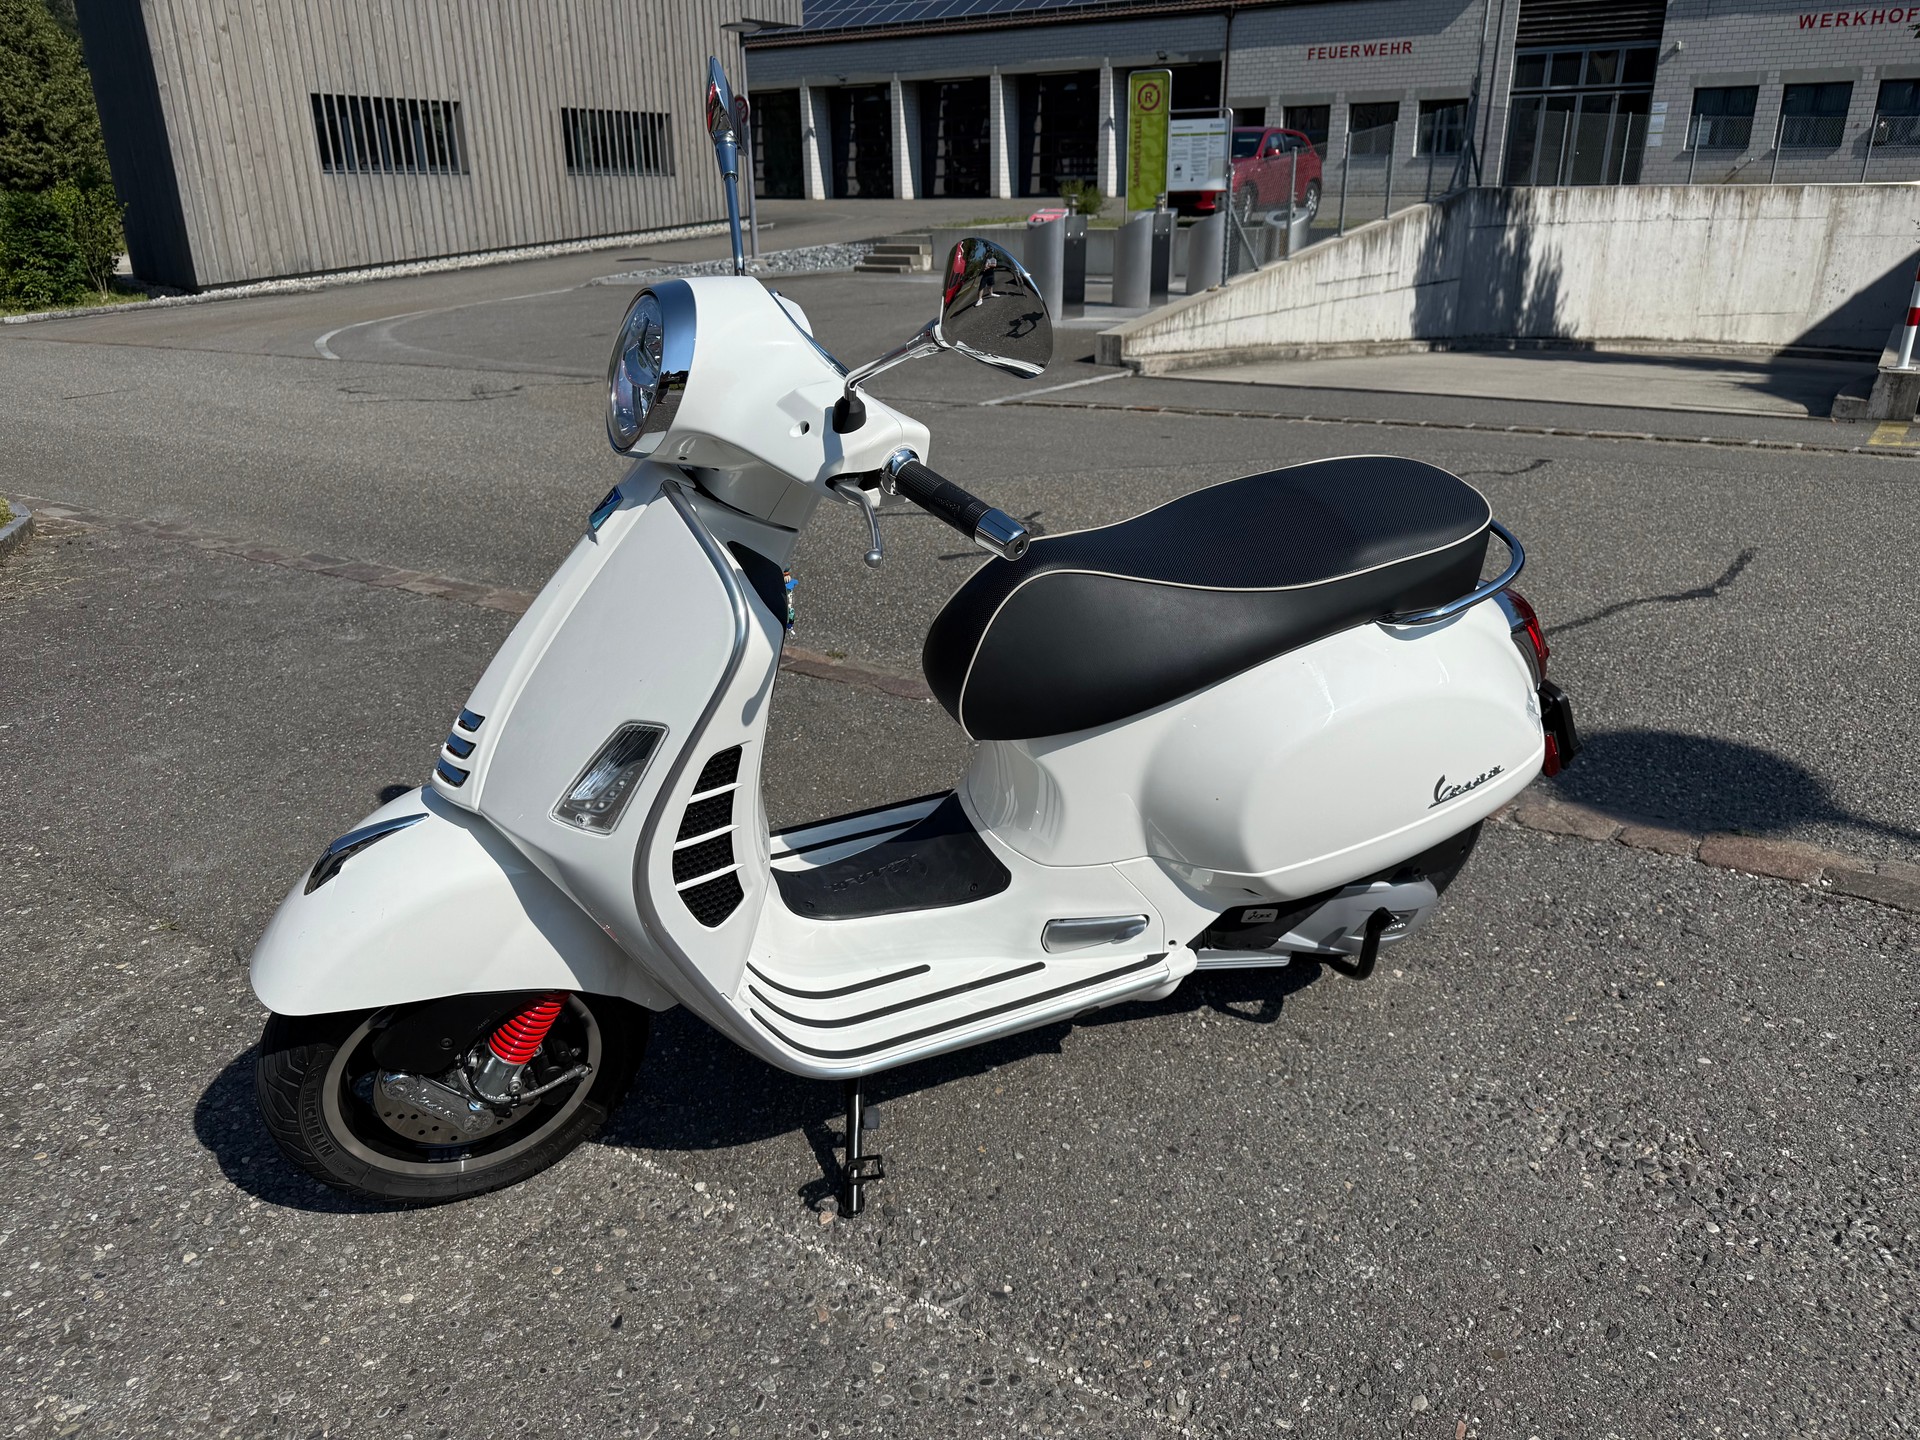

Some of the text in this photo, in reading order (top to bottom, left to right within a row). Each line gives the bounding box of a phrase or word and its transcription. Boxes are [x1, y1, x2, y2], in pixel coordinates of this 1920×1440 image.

[1799, 7, 1920, 29] WERKHOF
[1307, 41, 1413, 60] FEUERWEHR
[1144, 91, 1153, 103] R
[1132, 117, 1142, 188] SAMMELSTELLE
[303, 1086, 336, 1158] MICHELIN
